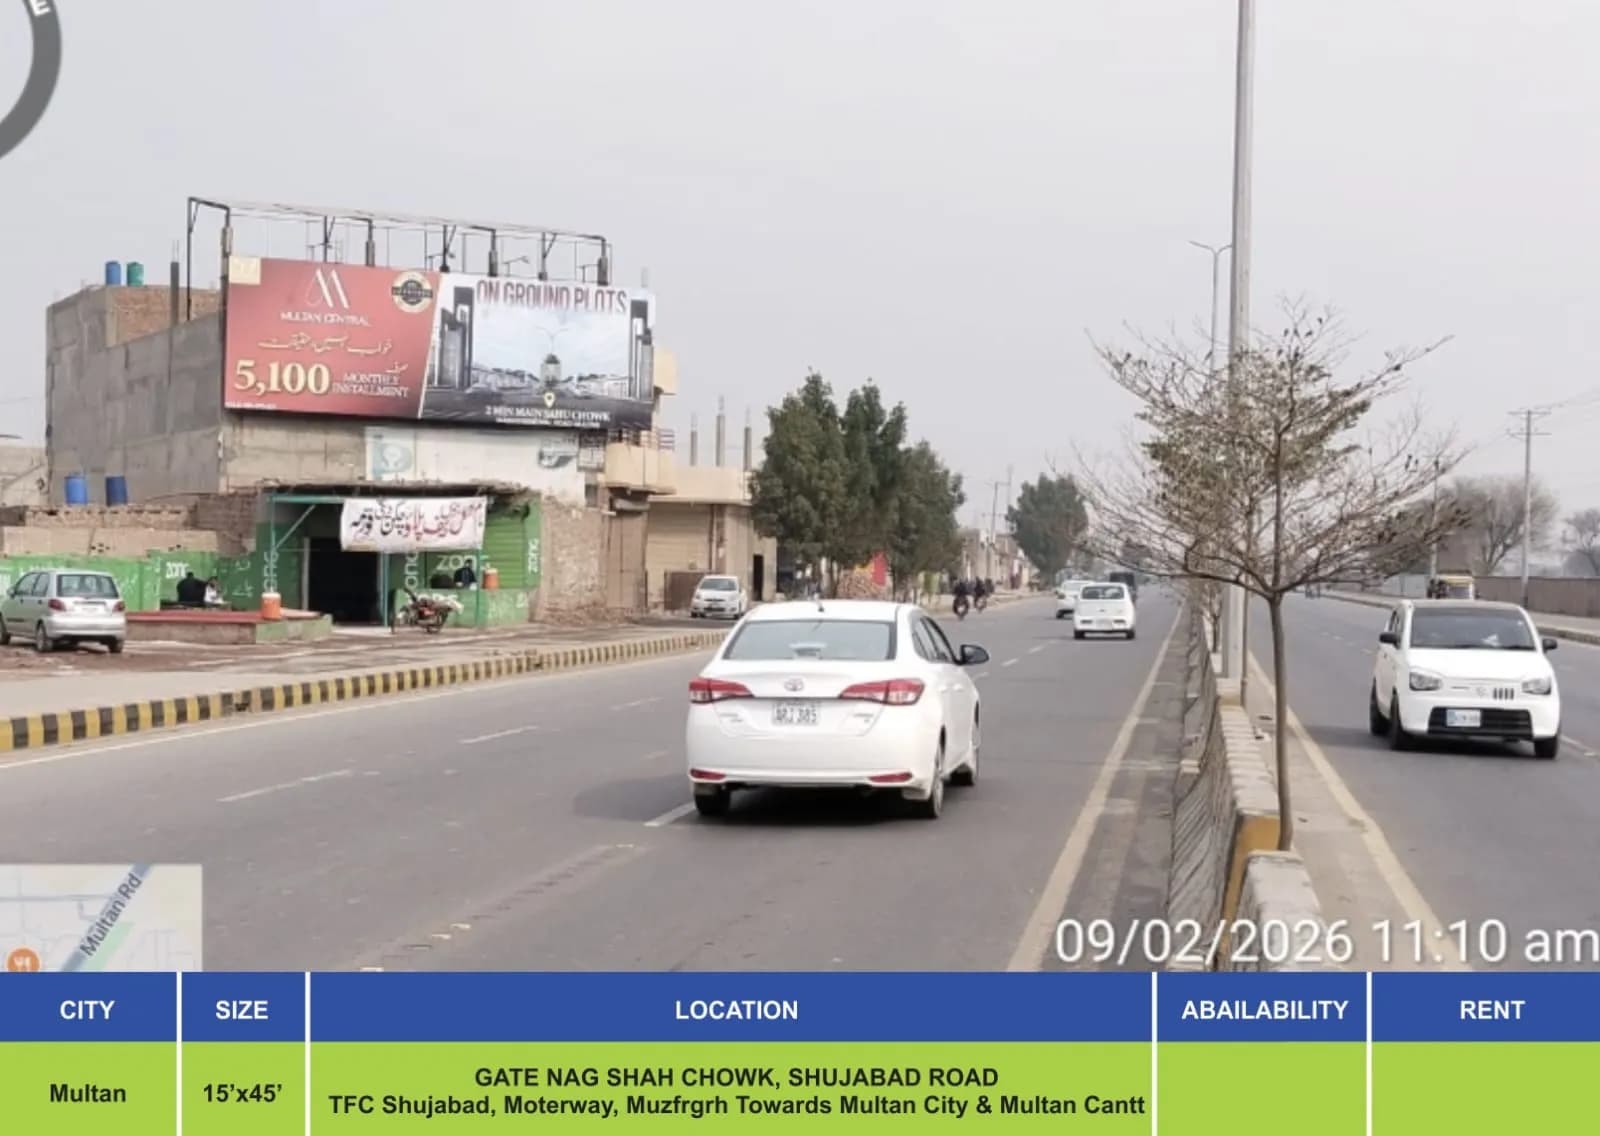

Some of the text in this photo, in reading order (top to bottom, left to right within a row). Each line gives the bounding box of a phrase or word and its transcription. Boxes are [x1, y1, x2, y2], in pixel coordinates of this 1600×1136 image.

[476, 279, 628, 314] ON GROUND PLOTS
[233, 358, 330, 397] 5,100
[331, 382, 409, 398] INSTALLMENT
[343, 372, 400, 386] MONTHLY
